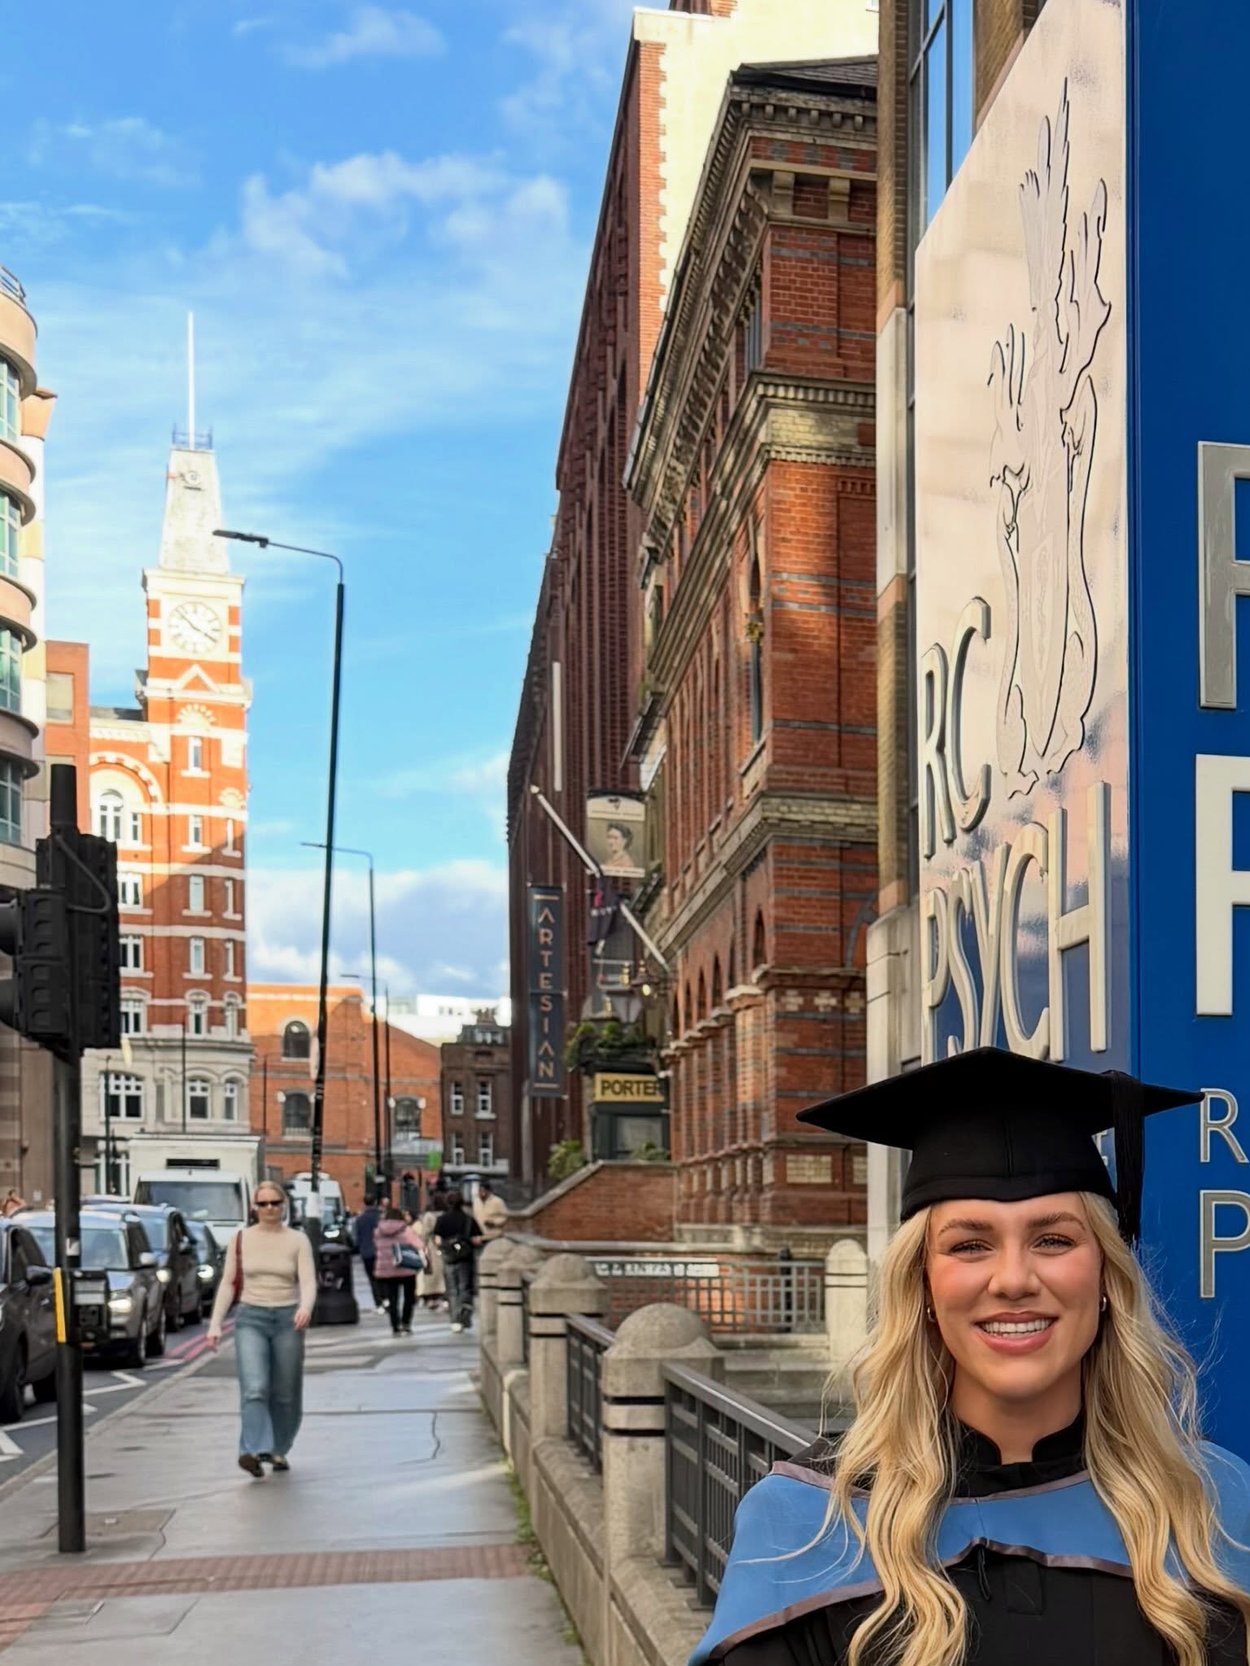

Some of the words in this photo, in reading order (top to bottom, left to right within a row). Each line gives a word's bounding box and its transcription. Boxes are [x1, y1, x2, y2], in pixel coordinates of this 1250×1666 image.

[921, 596, 991, 859] RC
[537, 907, 555, 1078] ARTESIAN
[921, 779, 1112, 1068] PSYCH
